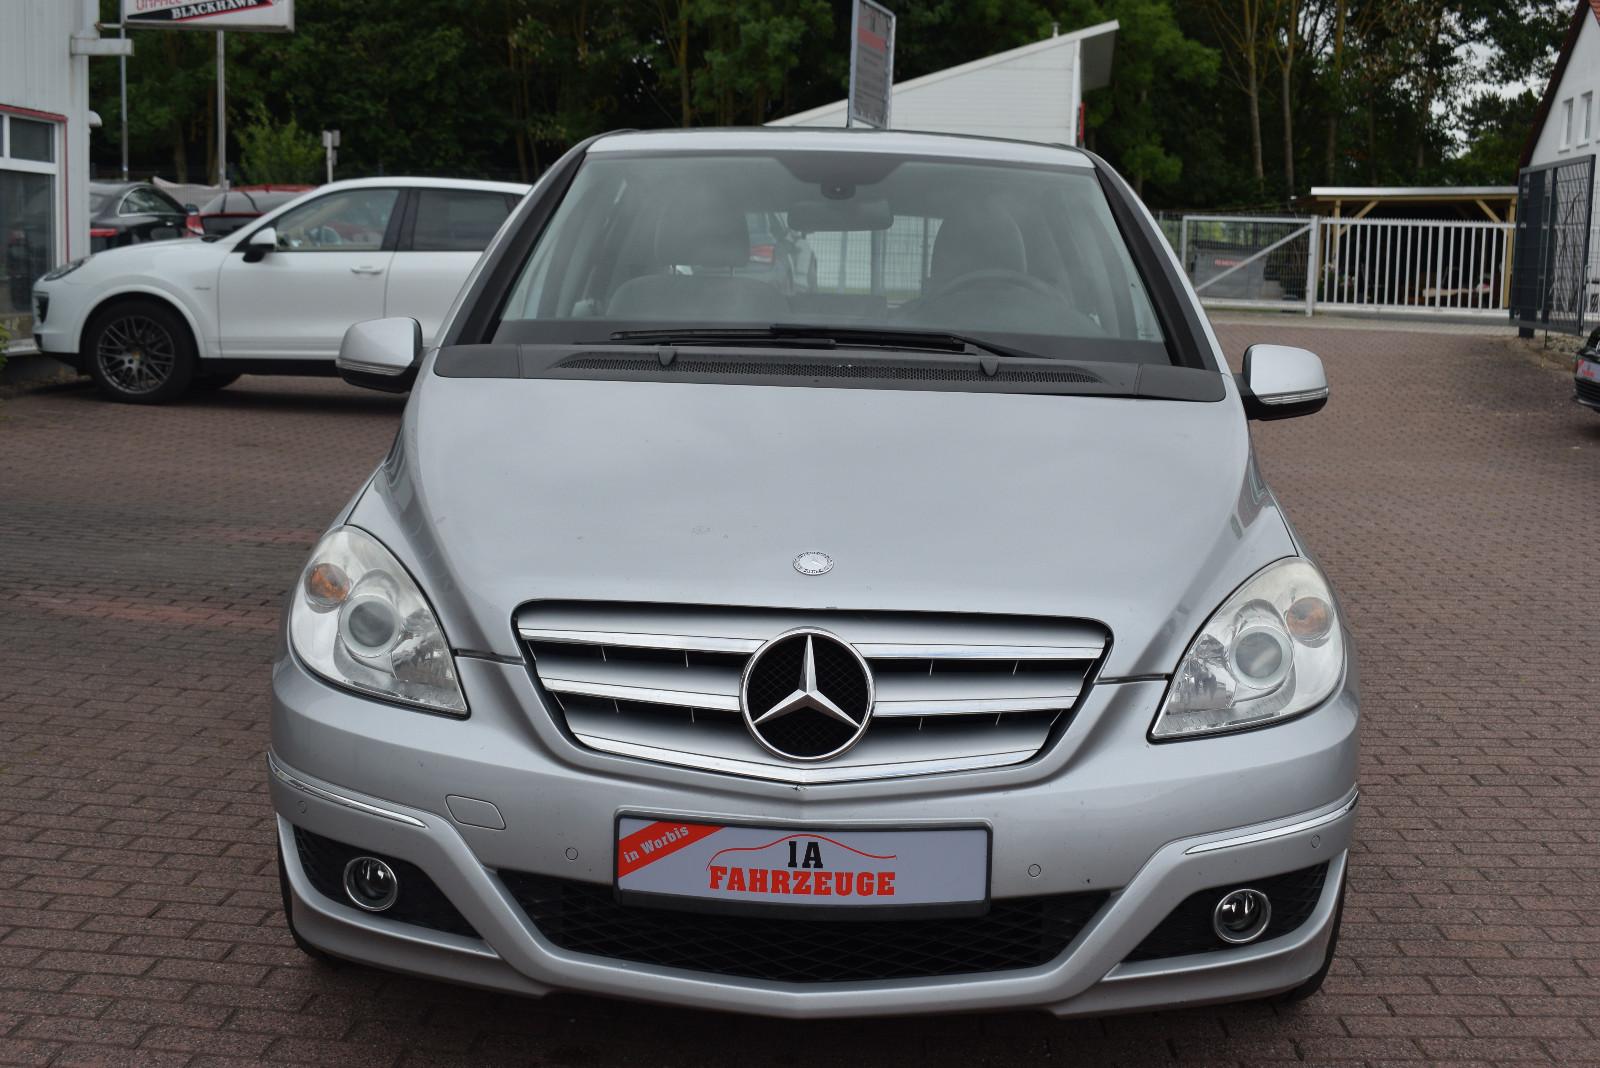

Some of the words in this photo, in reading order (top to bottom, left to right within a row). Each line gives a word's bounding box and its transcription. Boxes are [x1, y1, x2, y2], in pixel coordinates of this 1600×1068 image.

[624, 851, 640, 864] in
[640, 826, 689, 854] Worbis
[709, 865, 896, 896] FAHRZEUGE
